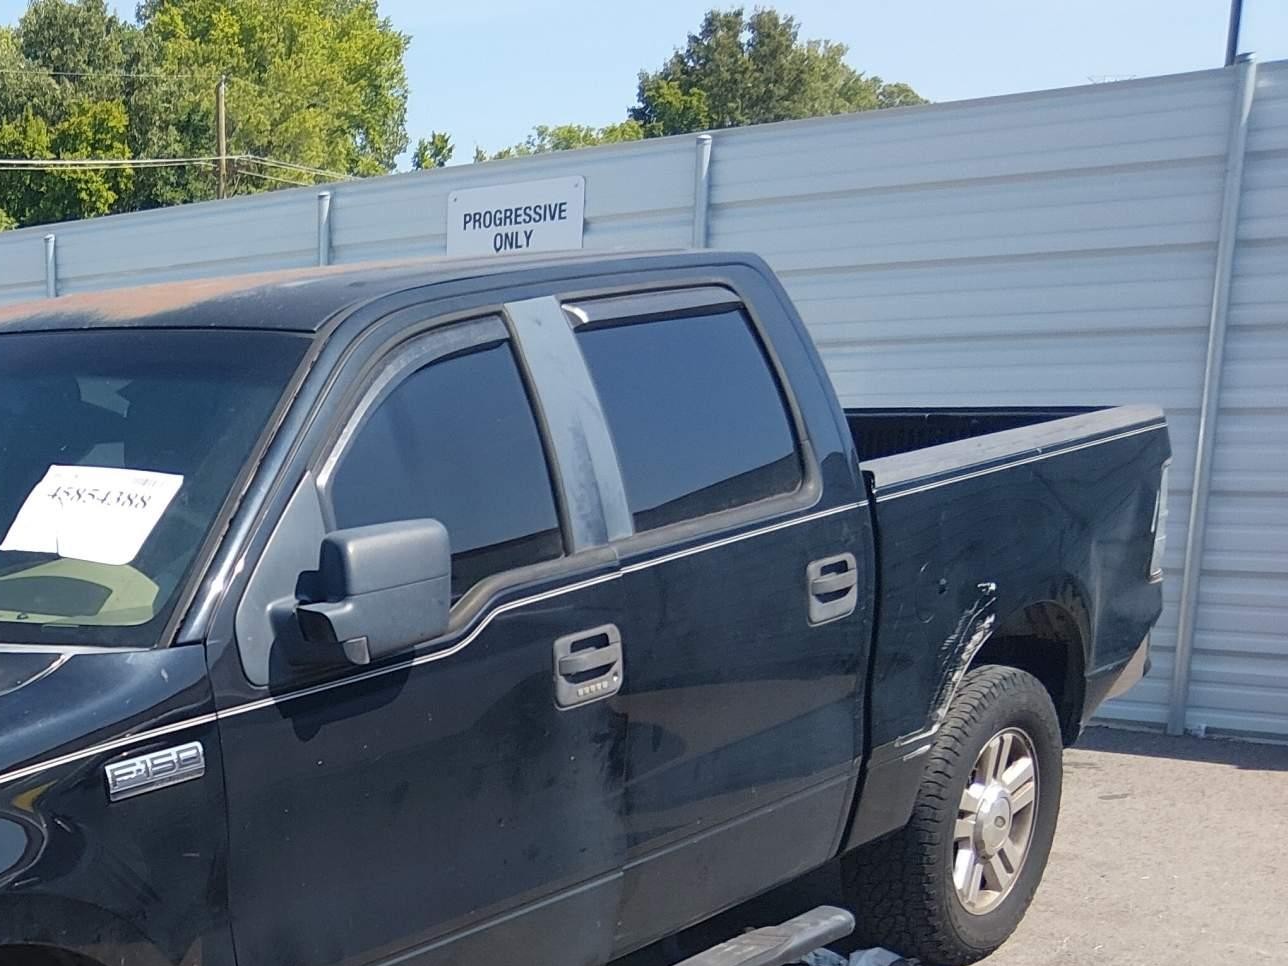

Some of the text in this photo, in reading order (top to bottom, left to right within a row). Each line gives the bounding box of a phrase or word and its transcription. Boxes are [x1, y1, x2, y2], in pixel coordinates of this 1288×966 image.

[463, 202, 568, 231] PROGRESSIVE
[493, 229, 534, 253] ONLY
[47, 486, 152, 509] 45854388
